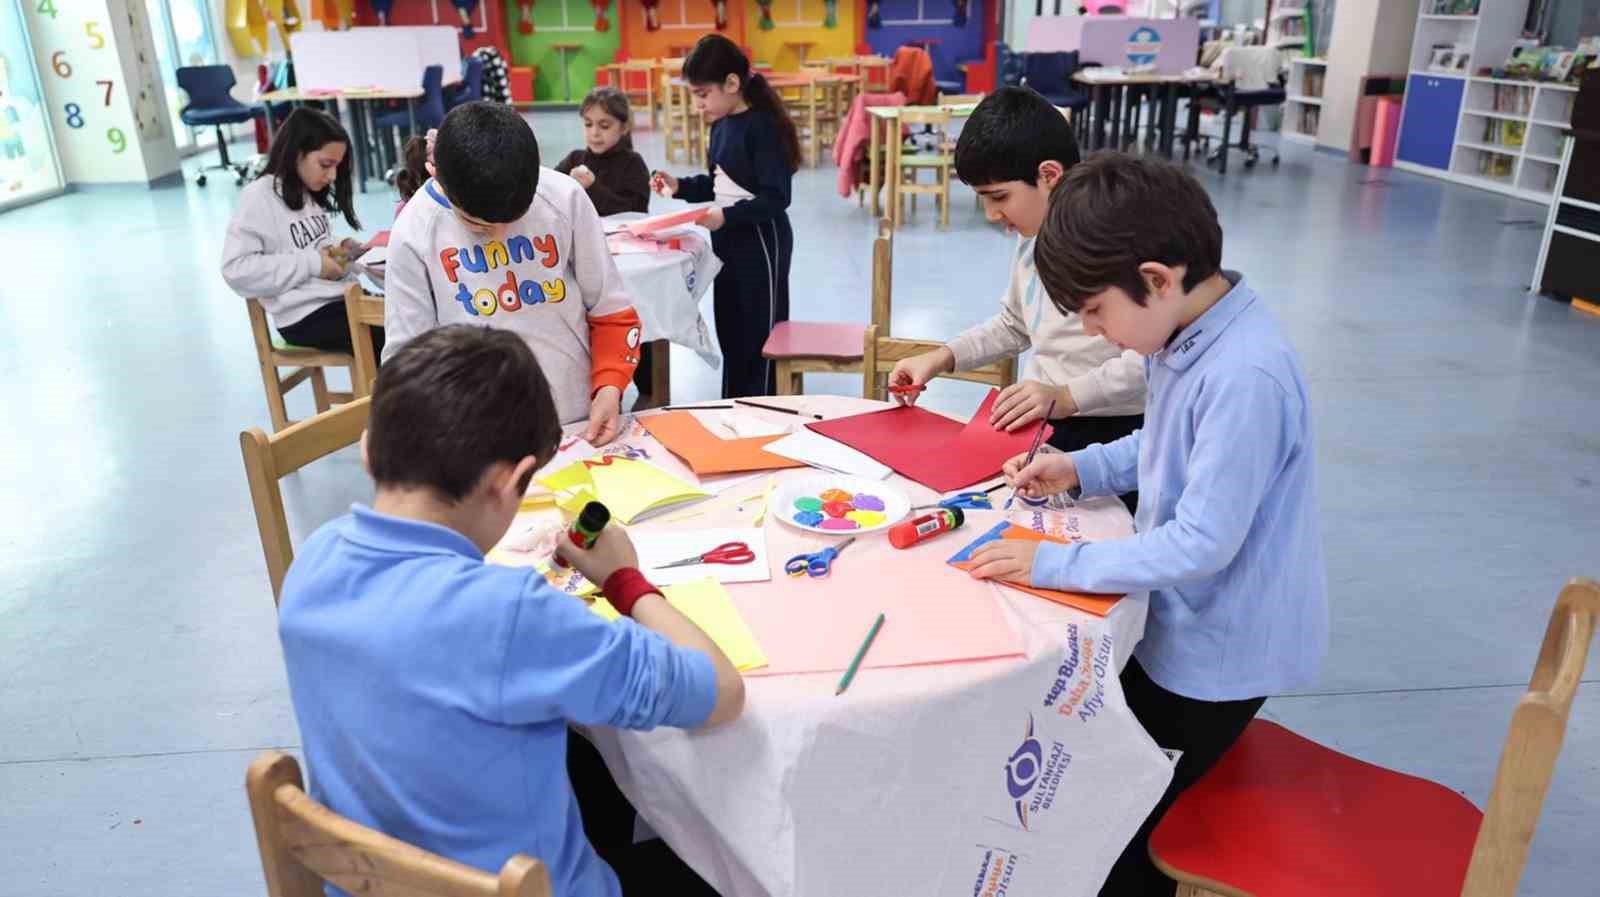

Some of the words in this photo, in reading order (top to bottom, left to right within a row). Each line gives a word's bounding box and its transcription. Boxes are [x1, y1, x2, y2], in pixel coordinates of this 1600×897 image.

[36, 0, 58, 18] 4
[84, 21, 105, 49] 5
[51, 50, 72, 78] 6
[95, 80, 113, 107] 7
[64, 102, 85, 129] 8
[106, 127, 128, 154] 9
[455, 270, 566, 316] today
[1093, 634, 1112, 679] Olsun
